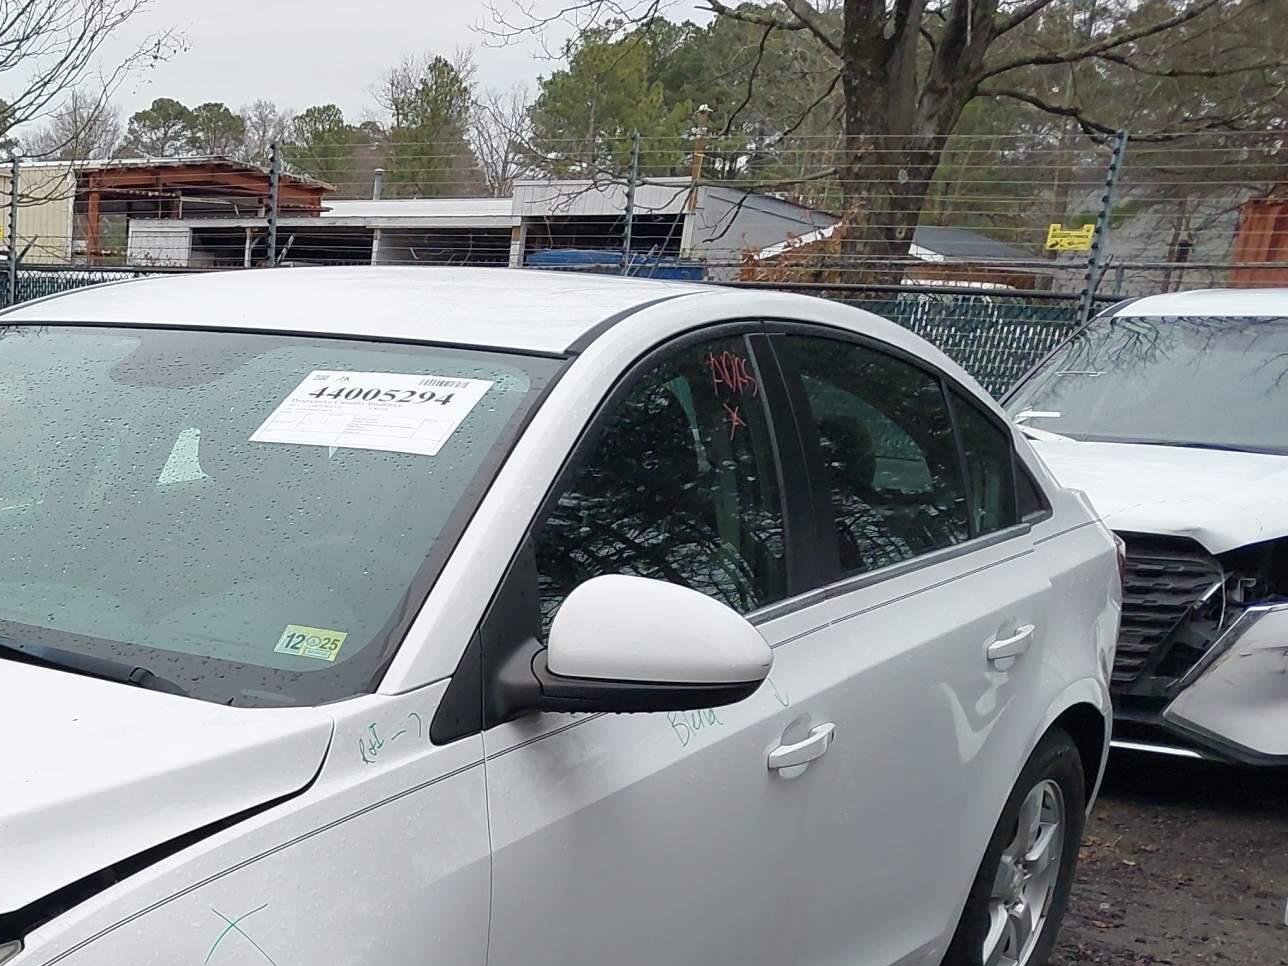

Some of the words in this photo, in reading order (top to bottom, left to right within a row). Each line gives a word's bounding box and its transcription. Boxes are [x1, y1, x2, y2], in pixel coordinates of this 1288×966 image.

[308, 386, 455, 406] 44005294
[285, 632, 306, 650] 12
[319, 637, 340, 651] 25
